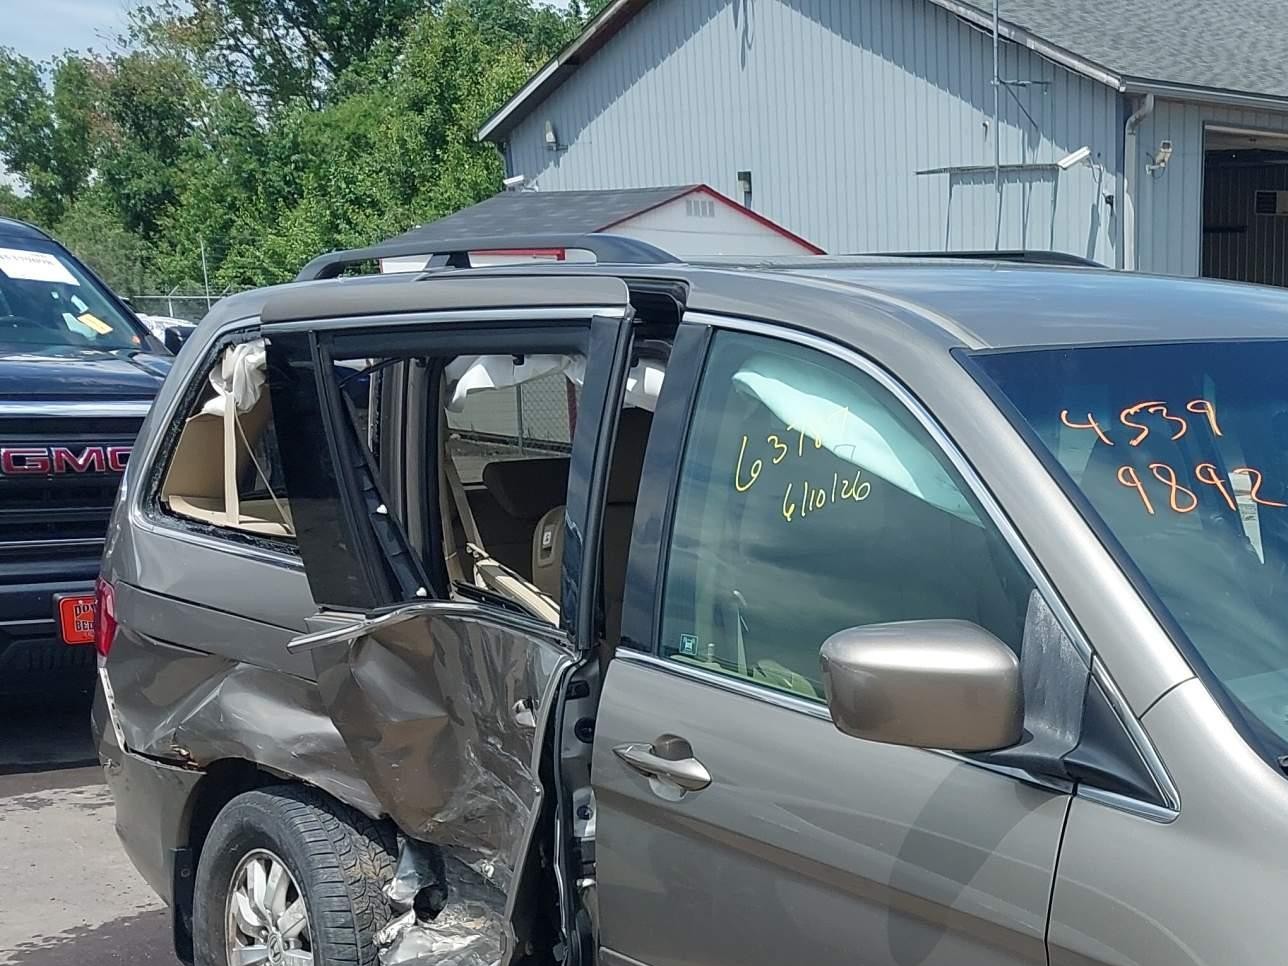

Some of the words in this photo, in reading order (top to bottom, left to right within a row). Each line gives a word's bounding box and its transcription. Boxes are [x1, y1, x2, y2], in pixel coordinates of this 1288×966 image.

[1060, 399, 1224, 446] 4539
[782, 470, 871, 522] 6/10/26
[1116, 462, 1288, 515] 9892
